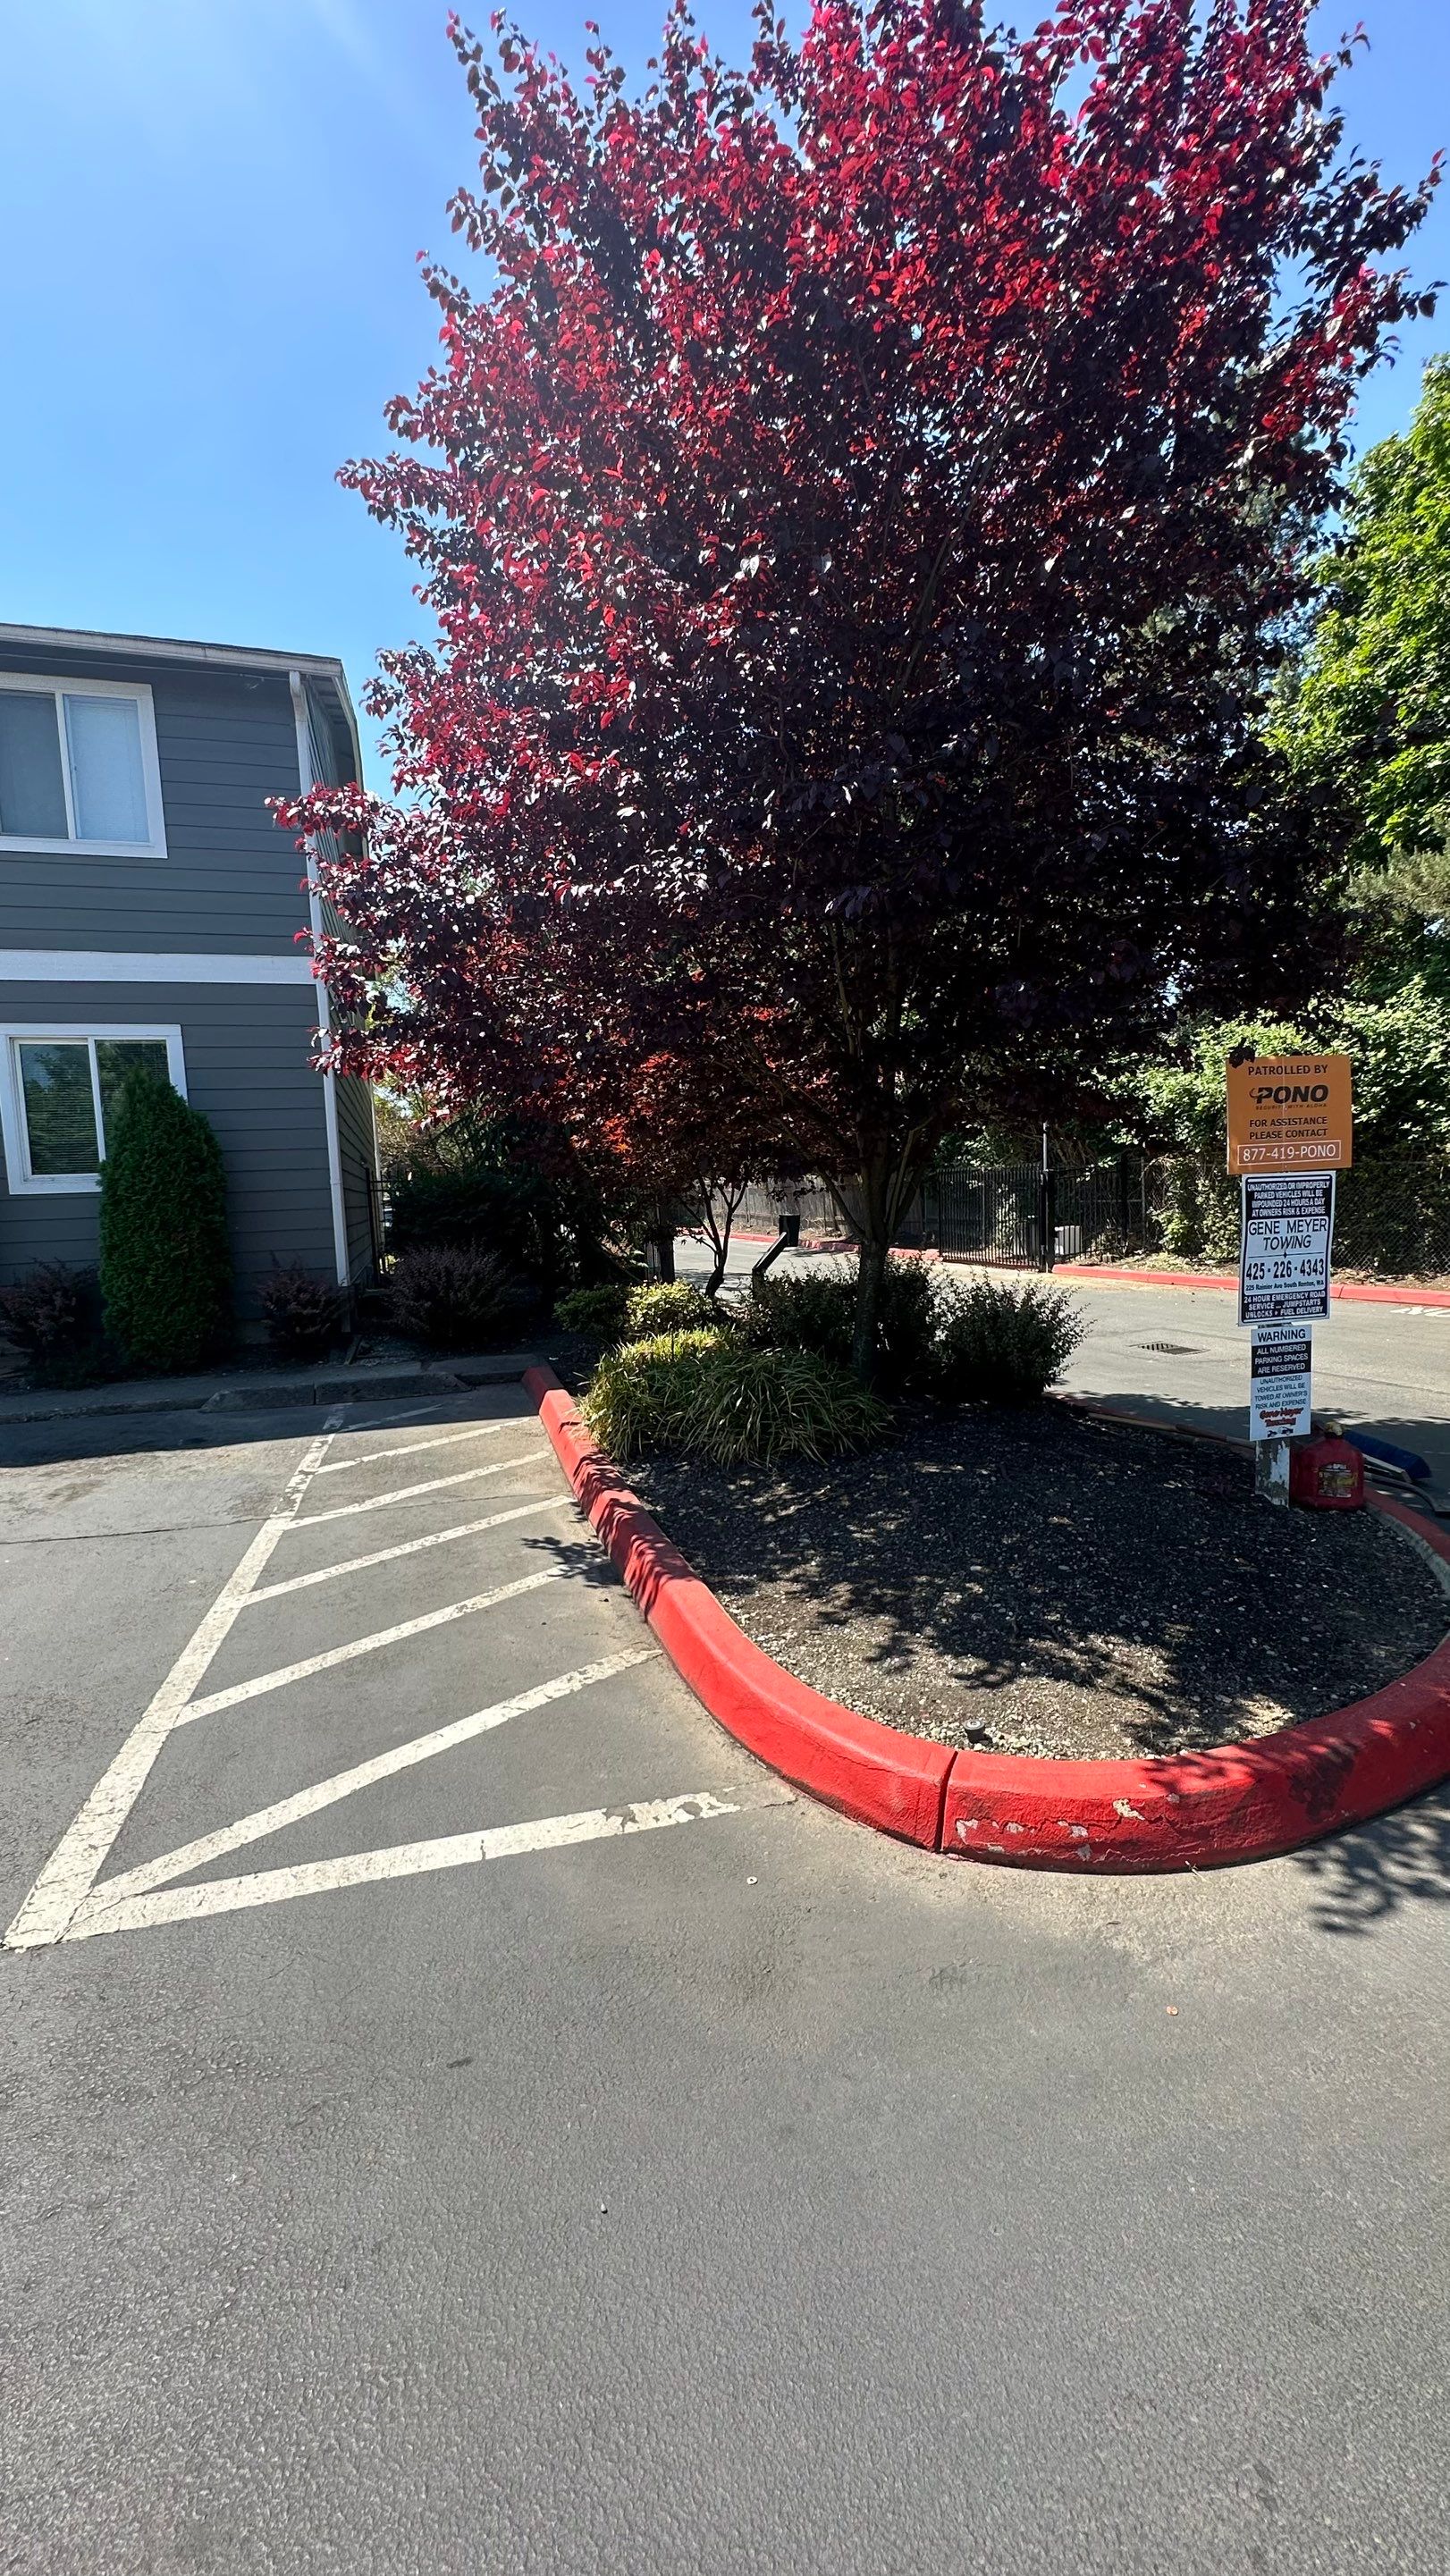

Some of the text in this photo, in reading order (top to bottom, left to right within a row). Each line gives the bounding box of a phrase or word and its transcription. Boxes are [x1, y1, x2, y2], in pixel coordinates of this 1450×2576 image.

[1248, 1065, 1328, 1075] PATROLLED BY
[1254, 1084, 1329, 1105] PONO
[1250, 1116, 1328, 1128] FOR ASSISTANCE
[1250, 1128, 1328, 1140] PLEASE CONTACT
[1243, 1144, 1336, 1161] 877-419-PONO
[1247, 1183, 1287, 1191] UNAUTHORIZED
[1296, 1181, 1330, 1189] IMPROPERLY
[1254, 1191, 1275, 1200] PARKED
[1276, 1191, 1302, 1199] VEHICLES
[1252, 1200, 1283, 1208] IMPOUNDED
[1291, 1199, 1309, 1207] HOURS
[1252, 1209, 1259, 1217] AT
[1283, 1208, 1295, 1216] RISK
[1301, 1207, 1326, 1215] EXPENSE
[1249, 1218, 1327, 1235] GENE MEYER
[1263, 1234, 1311, 1250] TOWING
[1252, 1295, 1270, 1303] HOUR
[1271, 1292, 1309, 1301] EMERGENCY
[1249, 1302, 1275, 1311] SERVICE
[1282, 1299, 1321, 1308] JUMPSTARTS
[1245, 1310, 1273, 1319] UNLOCKS
[1296, 1306, 1323, 1315] DELIVERY
[1257, 1328, 1305, 1343] WARNING
[1269, 1343, 1306, 1353] NUMBERED
[1255, 1353, 1309, 1365] PARKING SPACES
[1271, 1363, 1305, 1373] RESERVED
[1260, 1375, 1302, 1385] UNAUTHORIZED
[1257, 1385, 1283, 1393] VEHICLES
[1255, 1393, 1274, 1402] TOWED
[1281, 1399, 1306, 1407] EXPENSE
